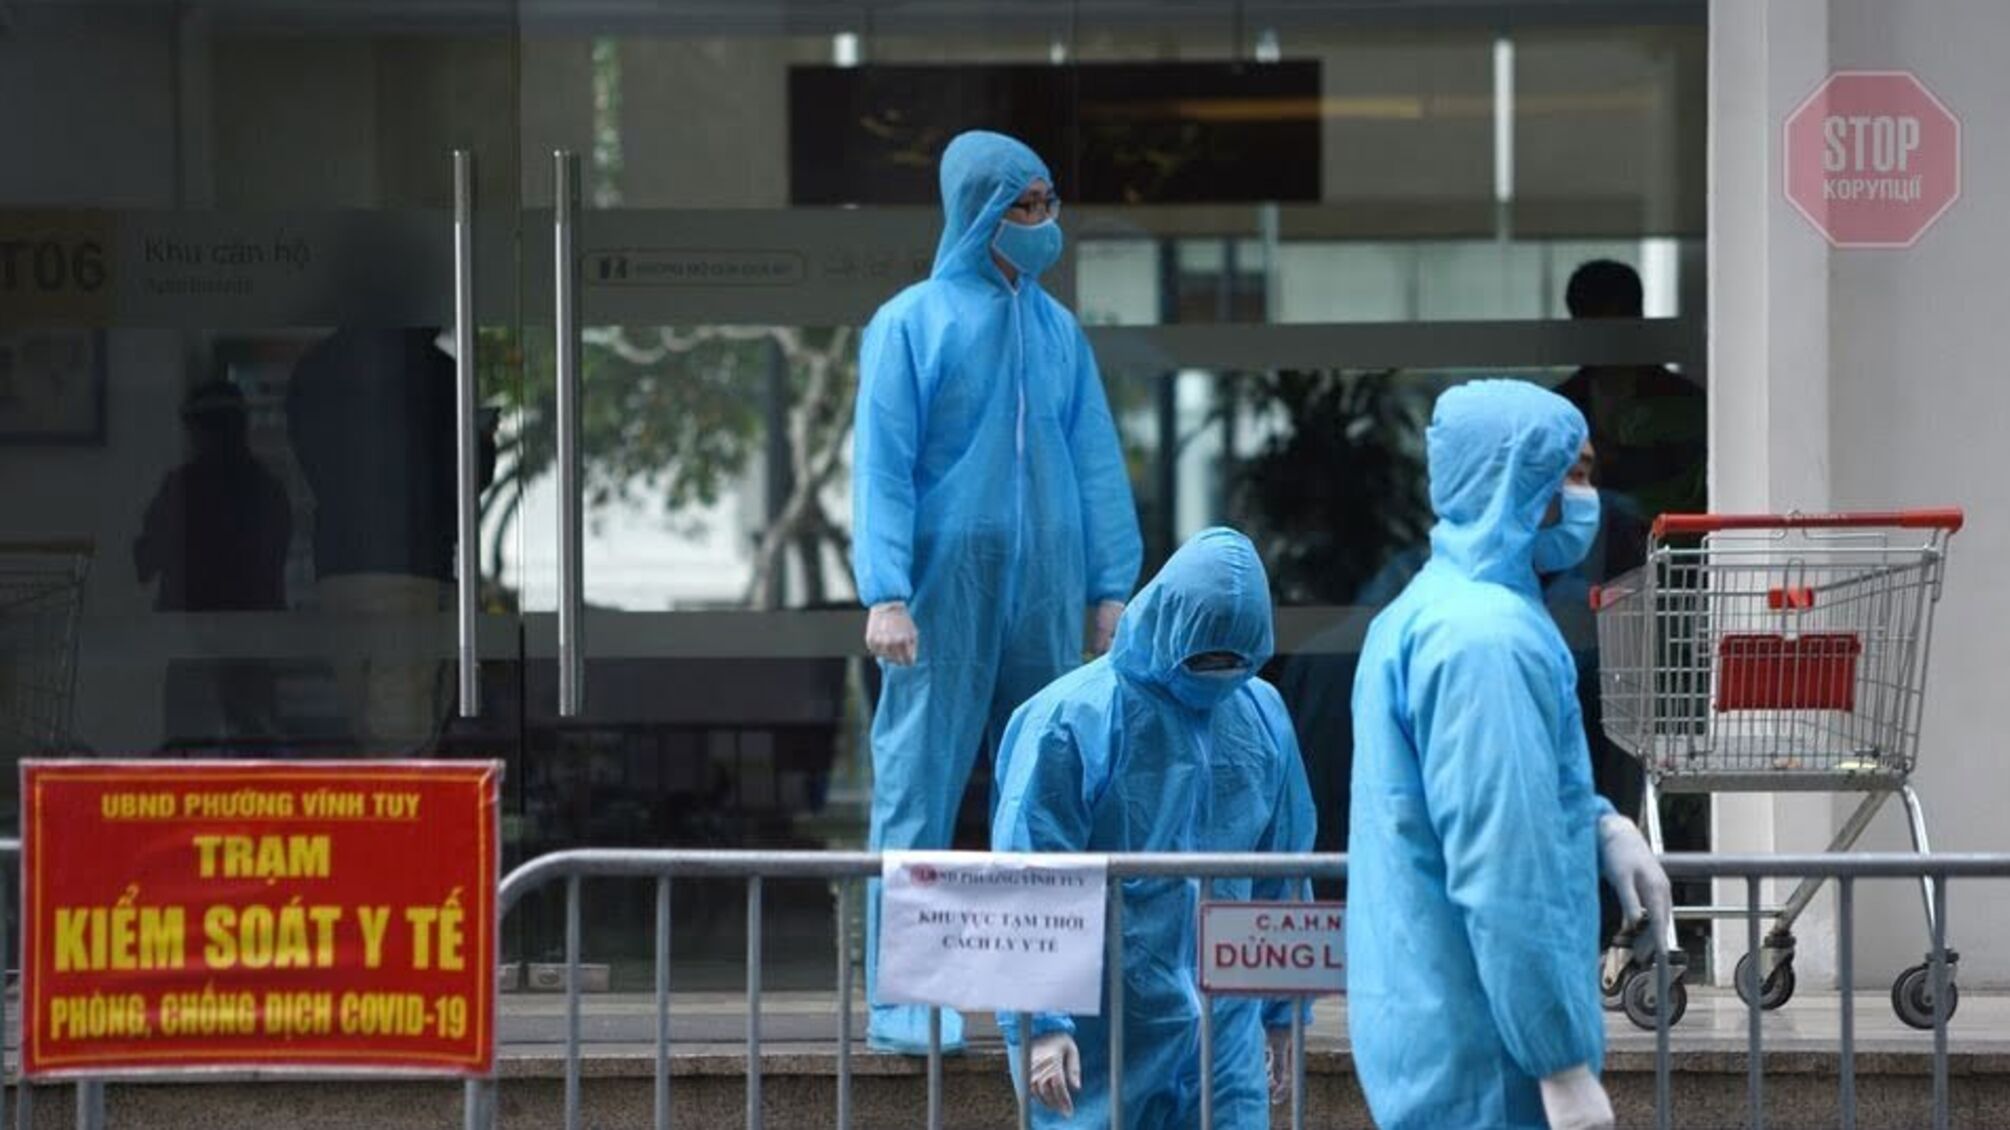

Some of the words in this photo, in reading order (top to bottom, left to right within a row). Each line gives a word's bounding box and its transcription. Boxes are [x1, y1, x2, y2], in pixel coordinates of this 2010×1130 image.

[102, 793, 175, 819] UBND
[372, 793, 420, 817] TUY
[193, 835, 330, 885] TRẠM
[54, 885, 186, 972] KIỂM
[204, 896, 340, 969] SOÁT
[358, 906, 390, 969] Y
[407, 887, 465, 971] TẾ
[265, 994, 331, 1041] DỊCH
[340, 996, 467, 1038] COVID-19
